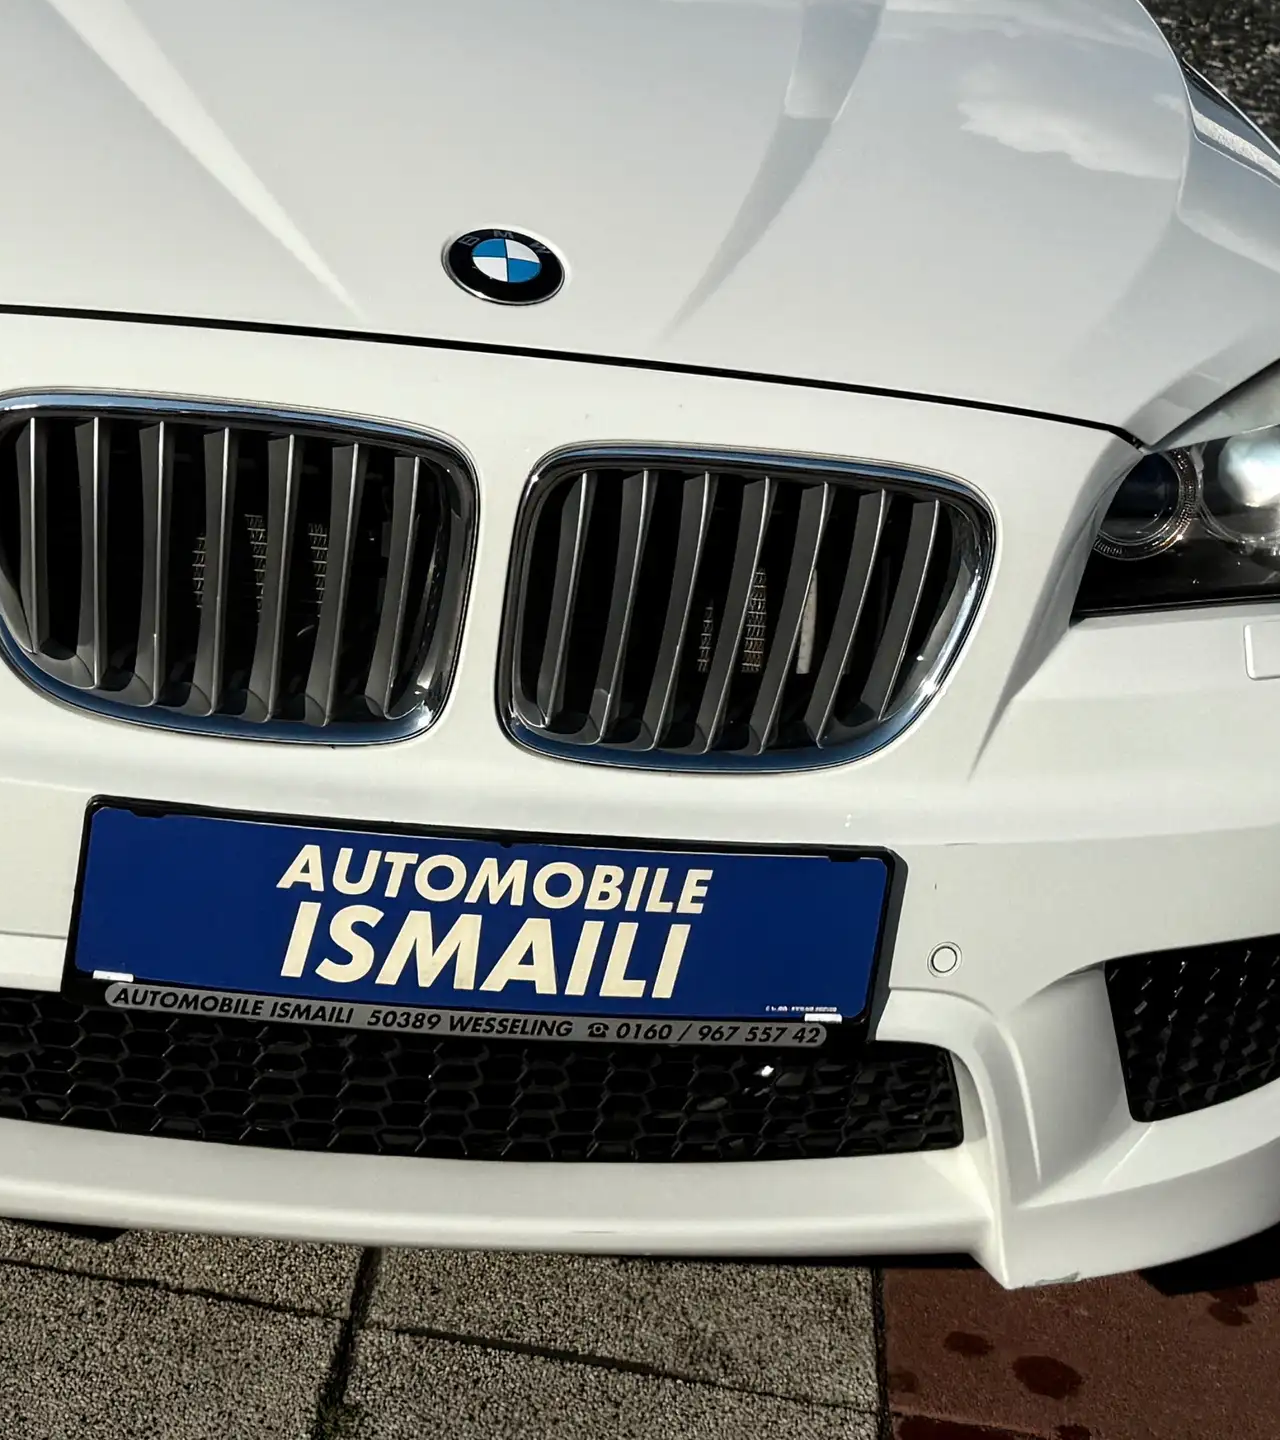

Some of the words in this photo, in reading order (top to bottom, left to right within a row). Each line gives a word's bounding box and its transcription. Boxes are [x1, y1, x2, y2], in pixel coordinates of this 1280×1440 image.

[458, 230, 551, 254] BMW
[277, 844, 713, 914] AUTOMOBILE
[280, 901, 694, 1000] ISMAILI
[112, 987, 264, 1016] AUTOMOBILE
[270, 1001, 354, 1024] ISMAILI
[367, 1010, 441, 1030] 50389
[449, 1015, 573, 1037] WESSELING
[616, 1022, 673, 1040] 0160
[677, 1023, 693, 1041] /
[698, 1025, 740, 1042] 967
[745, 1026, 786, 1043] 557
[792, 1027, 820, 1043] 42
